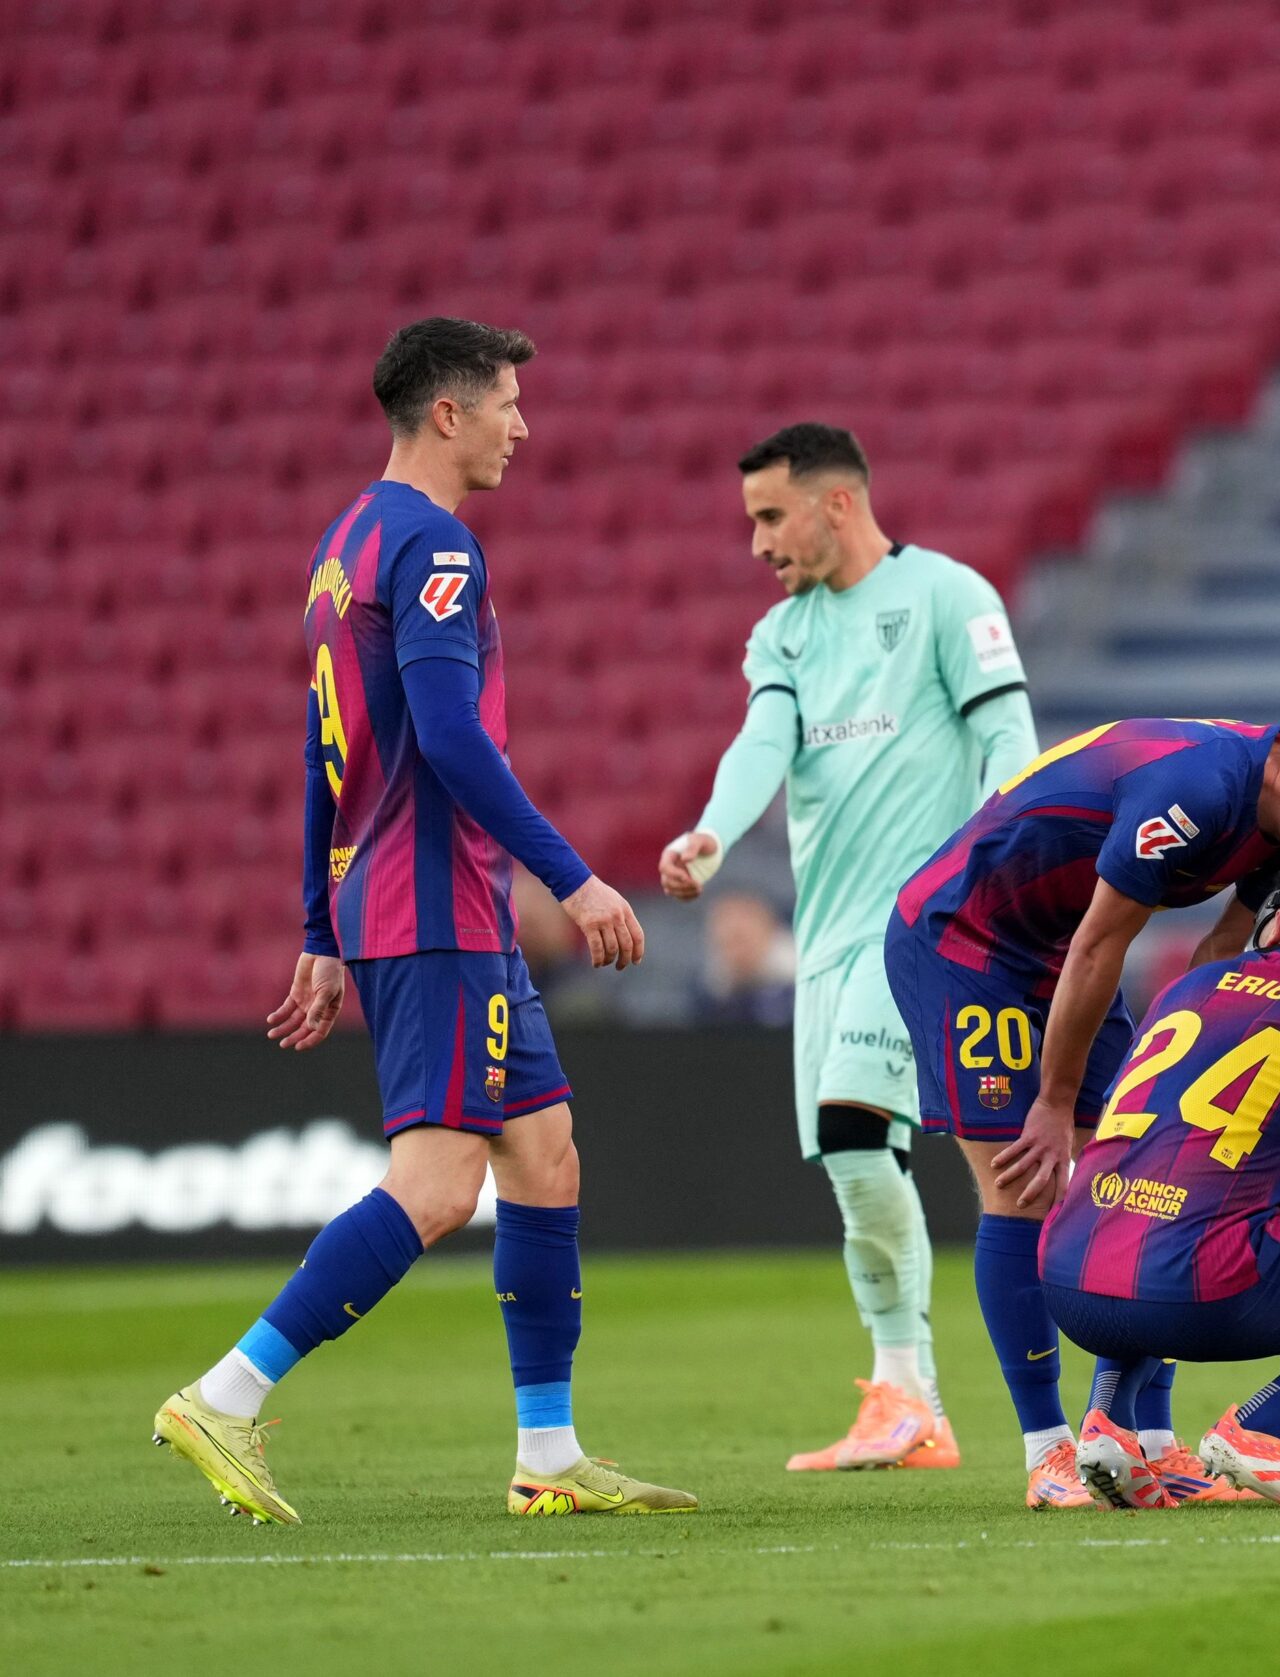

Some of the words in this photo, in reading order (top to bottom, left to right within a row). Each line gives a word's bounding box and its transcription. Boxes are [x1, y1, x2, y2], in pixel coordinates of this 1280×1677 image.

[316, 643, 348, 798] 9
[804, 713, 896, 746] utxabank
[486, 993, 509, 1061] 9
[955, 1004, 1033, 1071] 20
[1123, 1191, 1183, 1216] ACNUR
[1130, 1178, 1188, 1203] UNHCR
